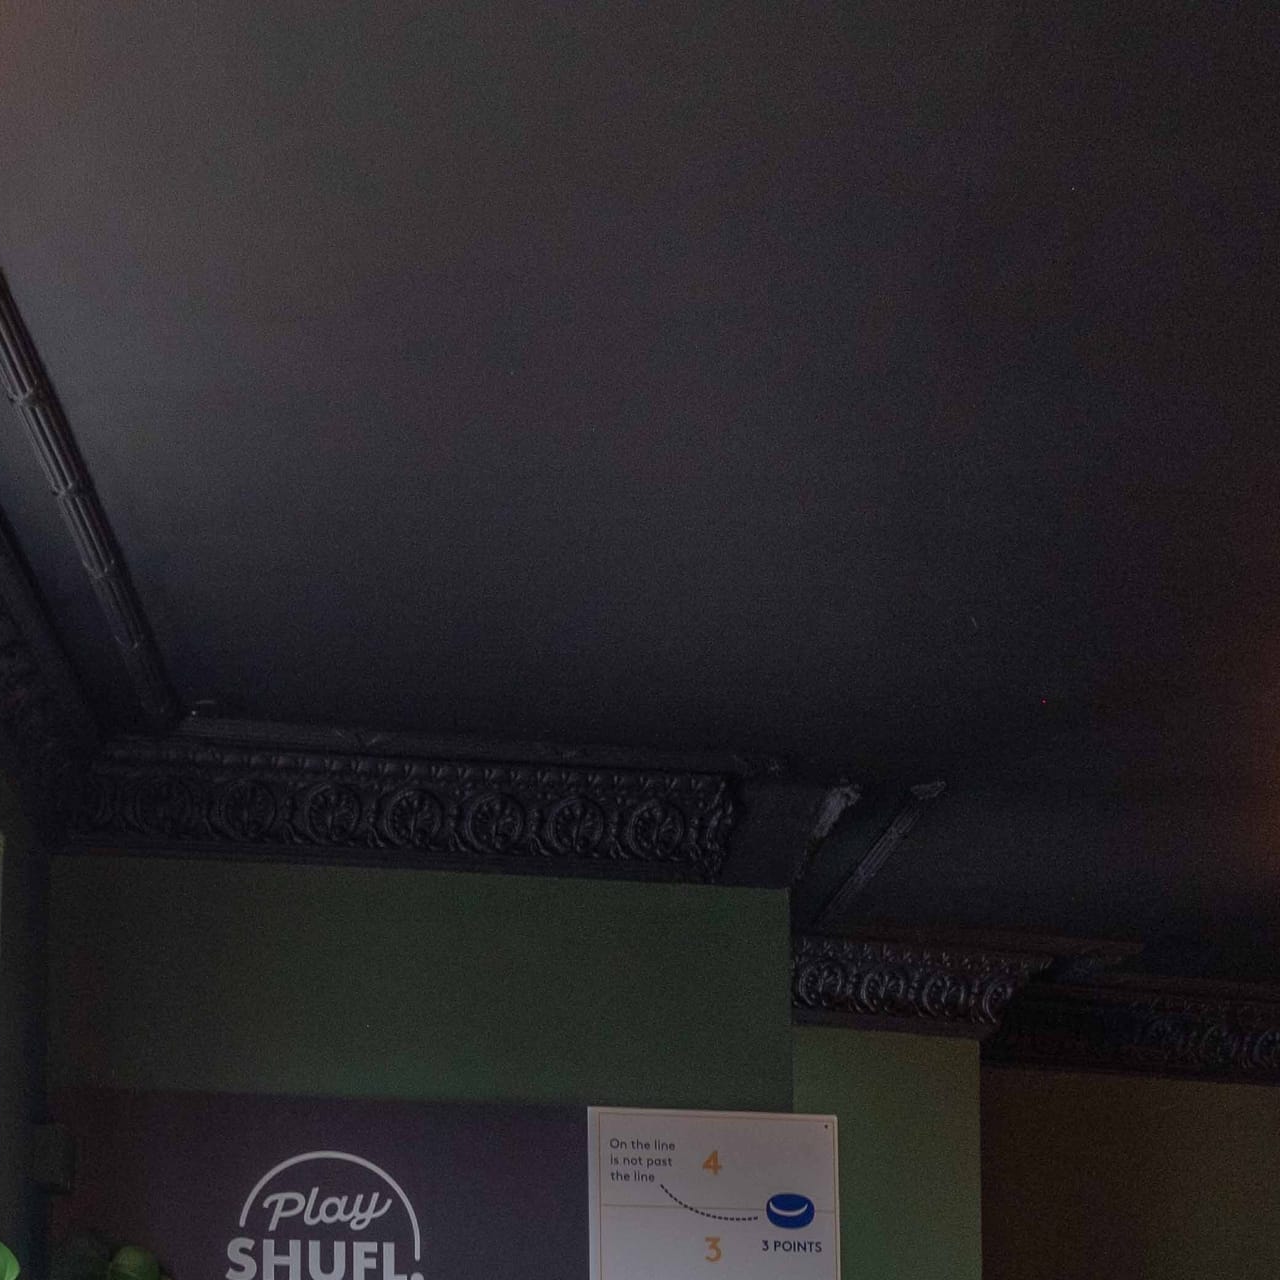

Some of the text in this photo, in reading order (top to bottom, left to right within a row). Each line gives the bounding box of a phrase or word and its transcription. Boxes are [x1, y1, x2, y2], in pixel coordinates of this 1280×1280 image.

[609, 1138, 676, 1151] On the line
[610, 1154, 673, 1169] is not past
[702, 1150, 723, 1175] 4
[610, 1171, 655, 1182] the line
[263, 1187, 392, 1231] Play
[704, 1236, 722, 1262] 3
[762, 1240, 823, 1253] 3 POINTS
